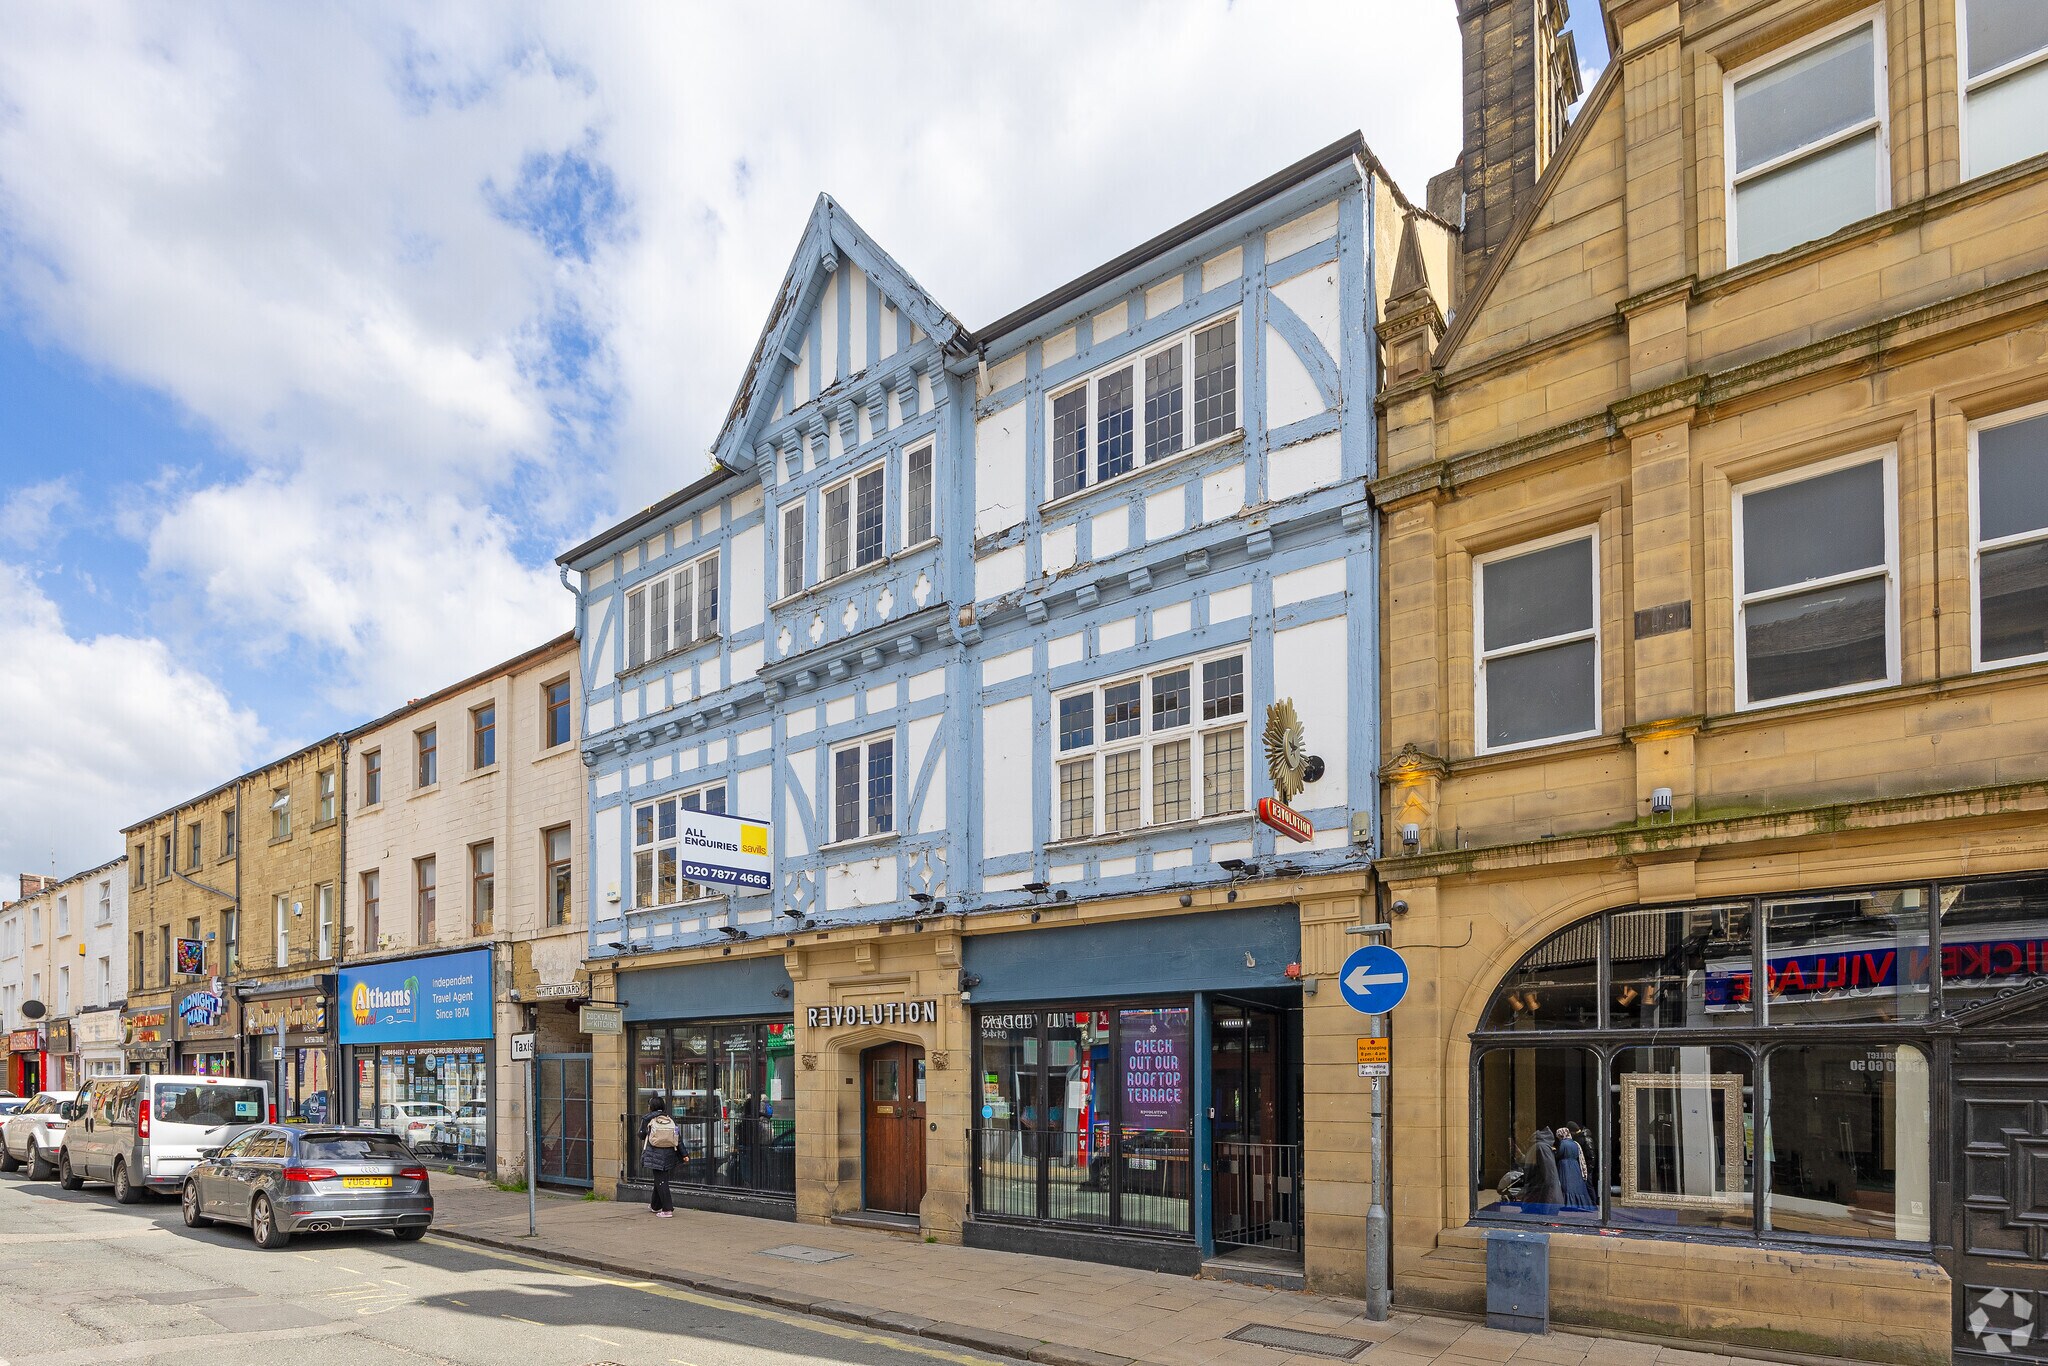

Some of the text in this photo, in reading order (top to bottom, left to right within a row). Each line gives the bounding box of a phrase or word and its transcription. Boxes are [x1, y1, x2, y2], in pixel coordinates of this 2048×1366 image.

[1272, 803, 1311, 835] REVOLUTION
[685, 827, 706, 838] ALL
[684, 837, 738, 852] ENQUIRIES
[742, 845, 767, 855] savills
[685, 865, 768, 885] 020 7877 4666
[432, 974, 473, 989] Independent
[537, 987, 552, 996] WHITE
[565, 984, 580, 994] YARD
[179, 991, 217, 1017] MIDNIGHT
[356, 986, 411, 1010] Althams
[432, 991, 473, 1004] Travel Agent
[187, 1008, 210, 1026] MART
[355, 1011, 378, 1026] travel
[435, 1008, 469, 1019] Since 1874
[586, 1012, 617, 1022] COCKTAILS
[807, 1001, 937, 1027] REVOLUTION
[593, 1021, 618, 1029] KITCHEN
[514, 1041, 533, 1053] Taxis
[1134, 1039, 1172, 1053] CHECK
[1129, 1056, 1178, 1070] OUT OUR
[1127, 1072, 1181, 1086] ROOFTOP
[1127, 1088, 1182, 1102] TERRACE
